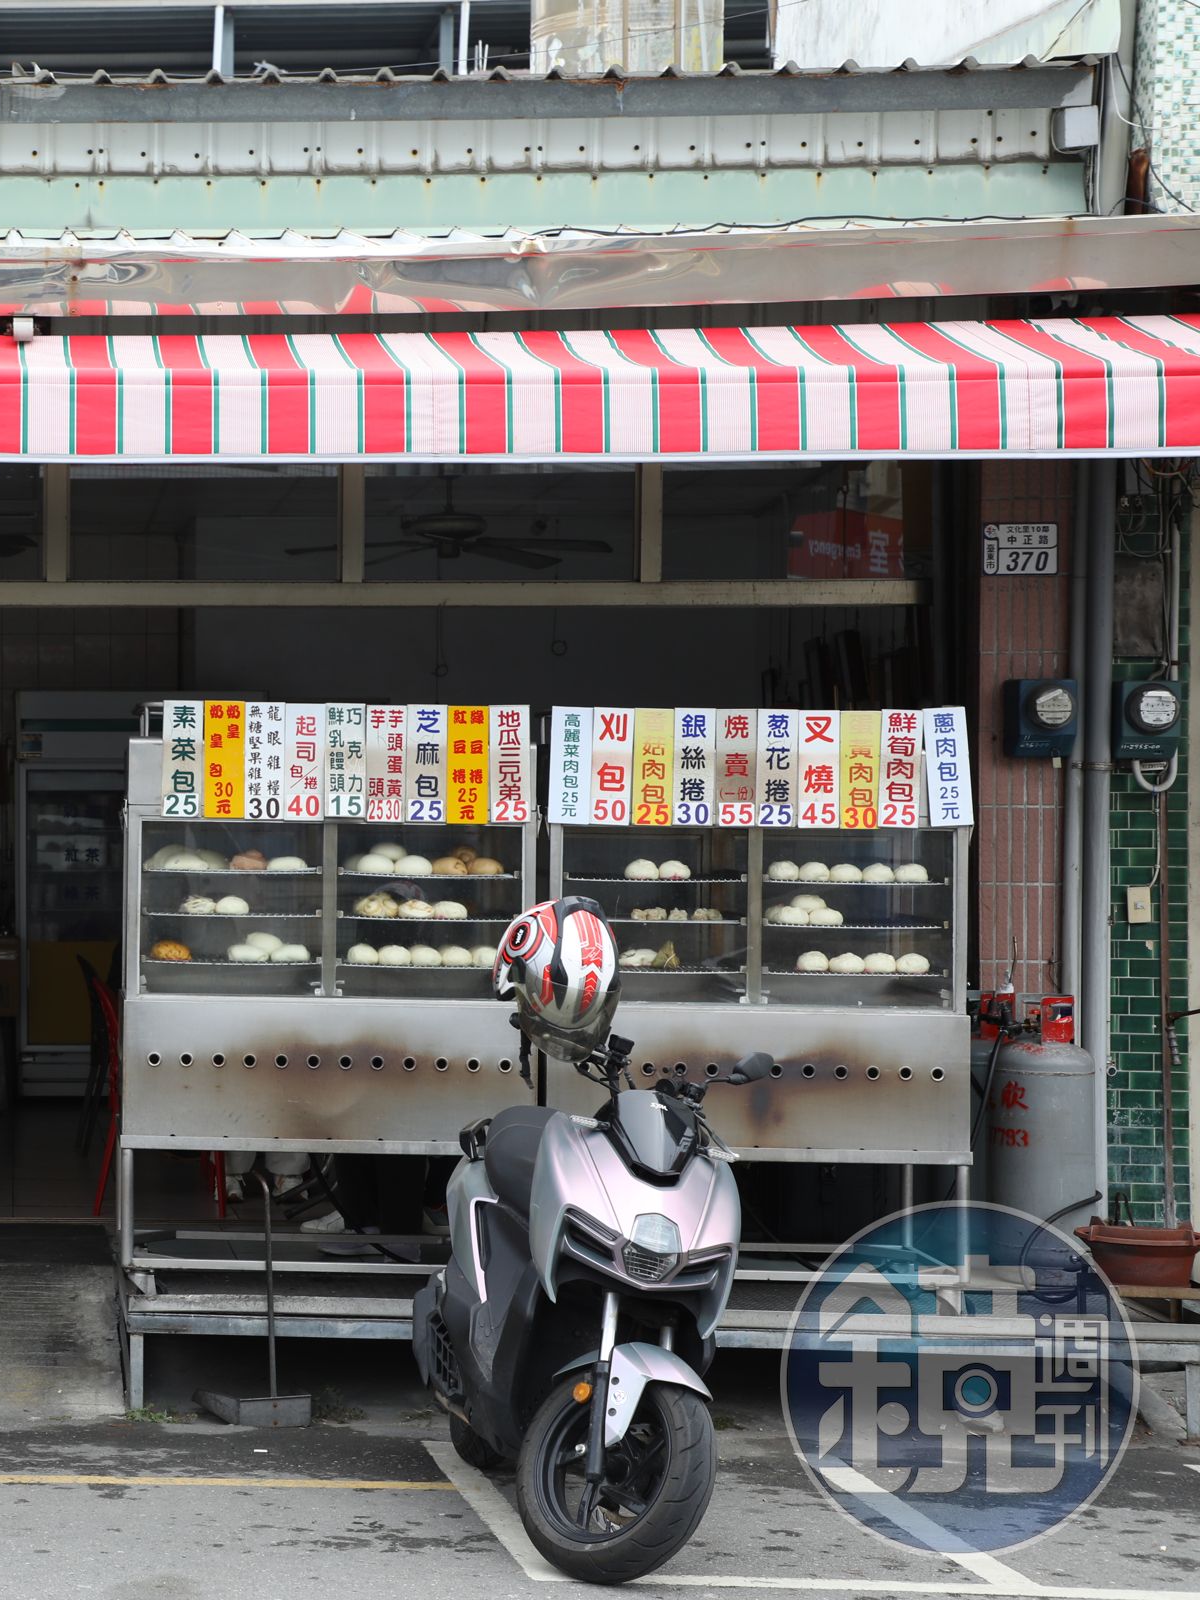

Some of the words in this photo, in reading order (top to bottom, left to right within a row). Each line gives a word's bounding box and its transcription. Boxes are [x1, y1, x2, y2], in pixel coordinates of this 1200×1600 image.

[1007, 534, 1049, 545] 中正路
[1006, 551, 1050, 572] 370
[171, 705, 196, 793] 素菜包
[295, 715, 317, 763] 起司
[328, 707, 345, 793] 鮮乳饅頭
[346, 707, 362, 793] 巧克力
[247, 705, 263, 796] 無糖堅果雜糧
[266, 705, 282, 796] 龍眼雜糧
[386, 709, 404, 798] 芋頭蛋黃
[415, 709, 441, 798] 芝麻包
[497, 709, 522, 801] 地瓜三兄弟
[597, 713, 628, 793] 刈包
[680, 714, 706, 802] 銀絲捲
[804, 716, 835, 794] 叉燒
[885, 712, 917, 803] 鮮筍肉包
[165, 794, 197, 815] 25
[249, 797, 280, 819] 30
[287, 795, 320, 817] 40
[330, 795, 362, 816] 15
[410, 800, 442, 821] 25
[495, 800, 528, 821] 25
[593, 799, 626, 821] 50
[636, 803, 669, 825] 25
[677, 803, 709, 825] 30
[721, 804, 753, 825] 55
[760, 804, 792, 825] 25
[802, 803, 836, 825] 45
[883, 804, 916, 826] 25
[844, 807, 877, 829] 30
